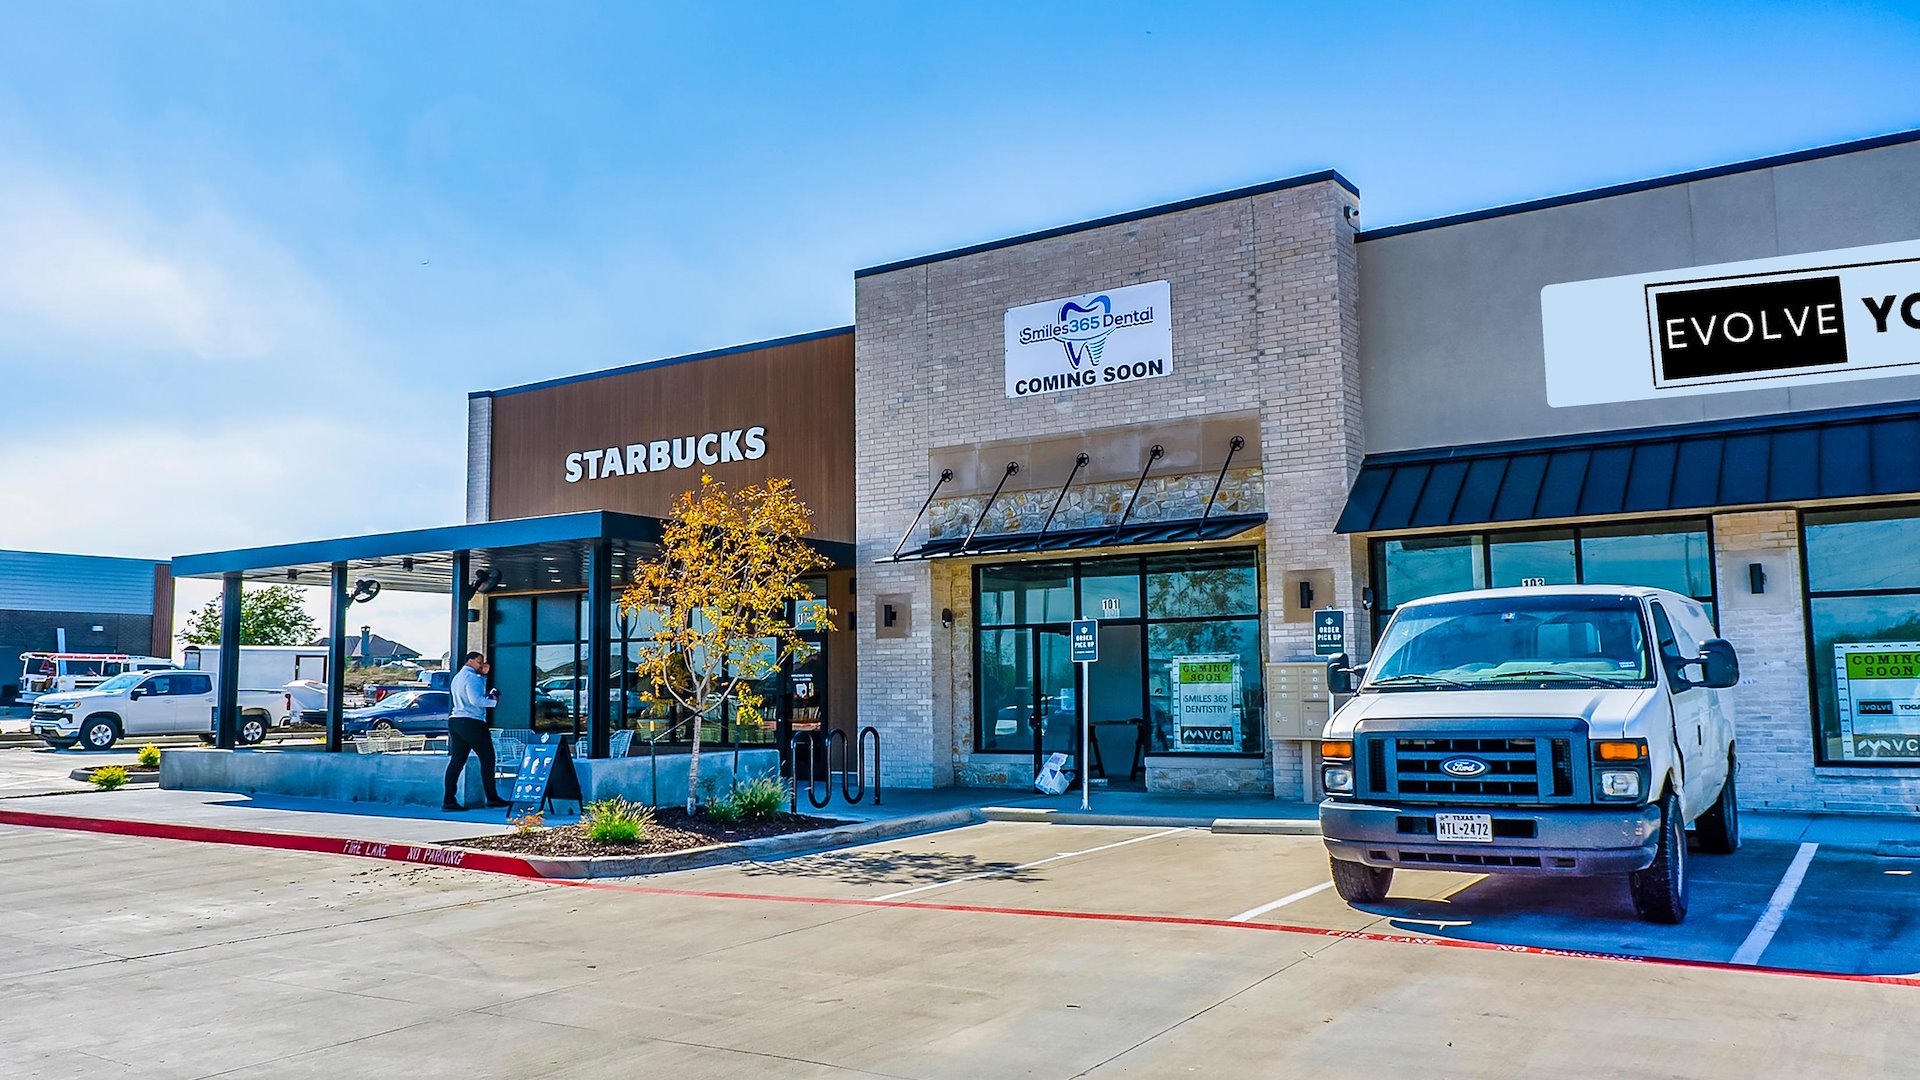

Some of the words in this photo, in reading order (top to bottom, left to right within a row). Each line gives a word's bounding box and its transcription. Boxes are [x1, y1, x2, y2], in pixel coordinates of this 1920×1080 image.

[1103, 306, 1154, 328] Dental
[1665, 303, 1839, 350] EVOLVE
[1015, 369, 1097, 396] COMING
[1103, 359, 1164, 383] SOON
[564, 426, 767, 483] STARBUCKS
[1103, 599, 1118, 610] 101
[1319, 626, 1340, 634] ORDER
[1317, 633, 1332, 641] PICK
[1183, 664, 1229, 673] COMING
[1865, 666, 1914, 676] SOON
[1190, 673, 1221, 682] SOON
[1184, 694, 1212, 703] SMILES
[1213, 694, 1228, 703] 365
[1185, 705, 1227, 714] DENTISTRY
[1204, 730, 1232, 740] VCM
[1452, 761, 1476, 772] Ford
[342, 840, 363, 855] FIRE
[365, 842, 390, 858] LANE
[406, 846, 422, 861] NO
[423, 848, 464, 866] PARKING
[1497, 944, 1528, 952] NO
